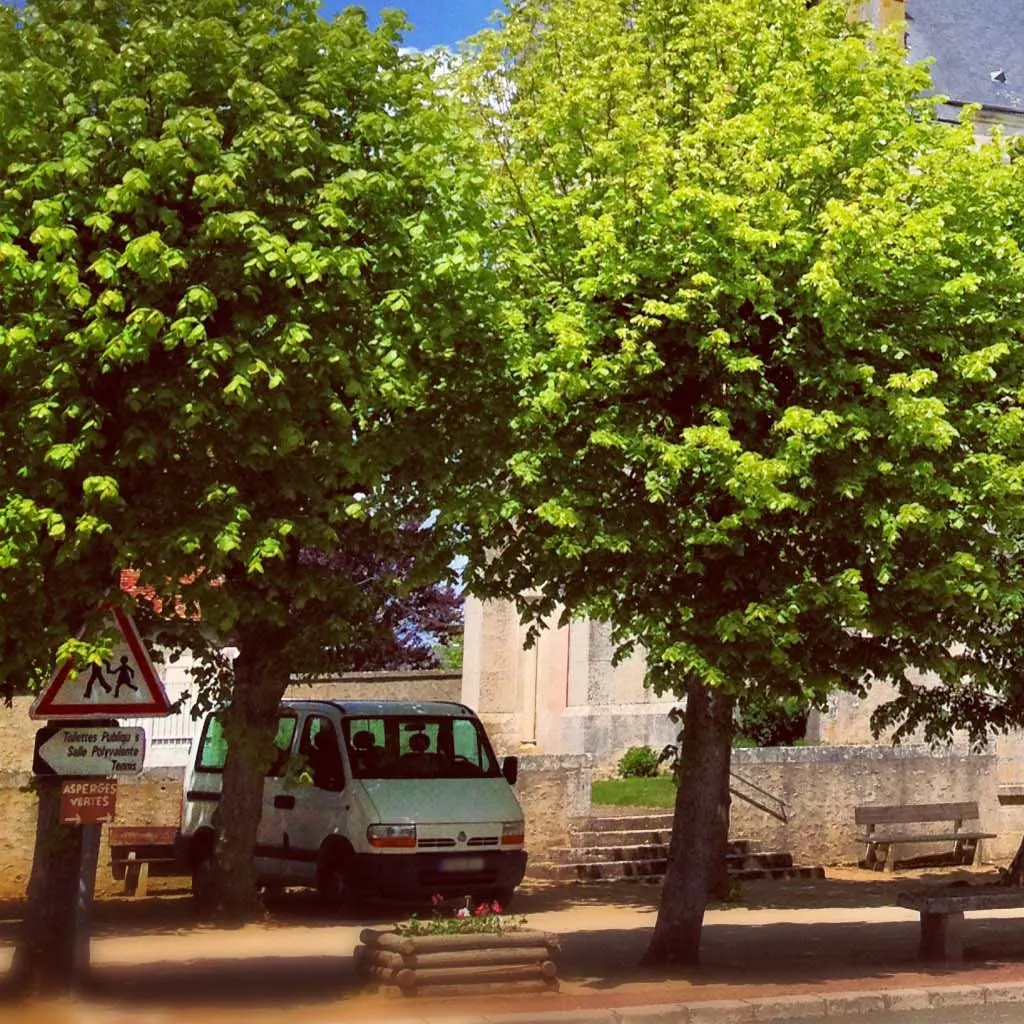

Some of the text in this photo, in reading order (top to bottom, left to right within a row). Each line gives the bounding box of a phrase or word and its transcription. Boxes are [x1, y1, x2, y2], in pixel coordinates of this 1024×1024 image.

[63, 731, 140, 744] Toilettes Publiqus
[67, 745, 139, 760] Salle Polyvalente
[112, 759, 137, 771] Tennis
[63, 783, 116, 794] ASPERGES
[70, 796, 109, 807] VERTES
